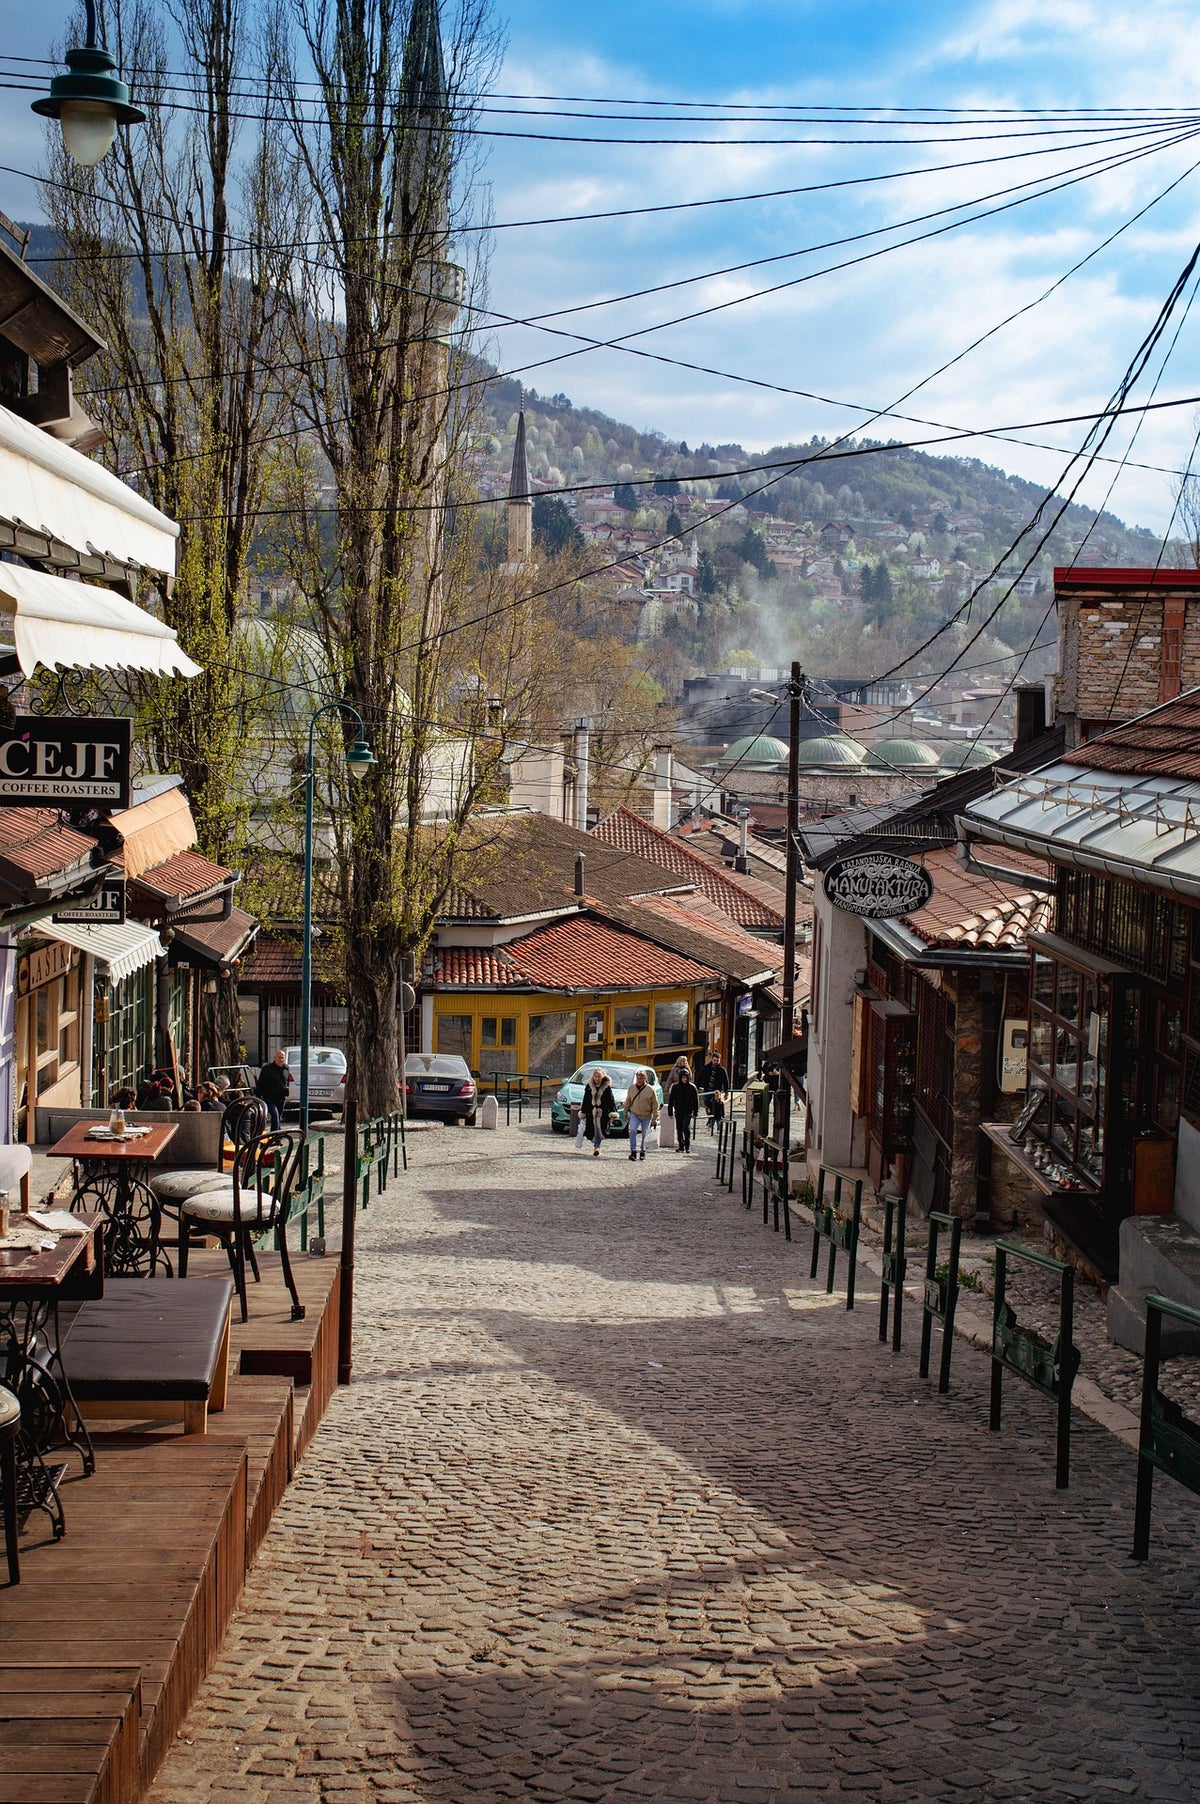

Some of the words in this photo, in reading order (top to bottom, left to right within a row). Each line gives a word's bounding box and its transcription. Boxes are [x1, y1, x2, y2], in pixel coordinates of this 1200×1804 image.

[2, 783, 49, 793] COFFEE
[53, 785, 115, 795] ROASTERS
[894, 858, 921, 875] RADNJA
[827, 876, 929, 898] MANUFAKTURA
[832, 897, 871, 917] HANDMADE
[872, 905, 908, 918] FUNCTIONAL
[908, 900, 920, 912] ART
